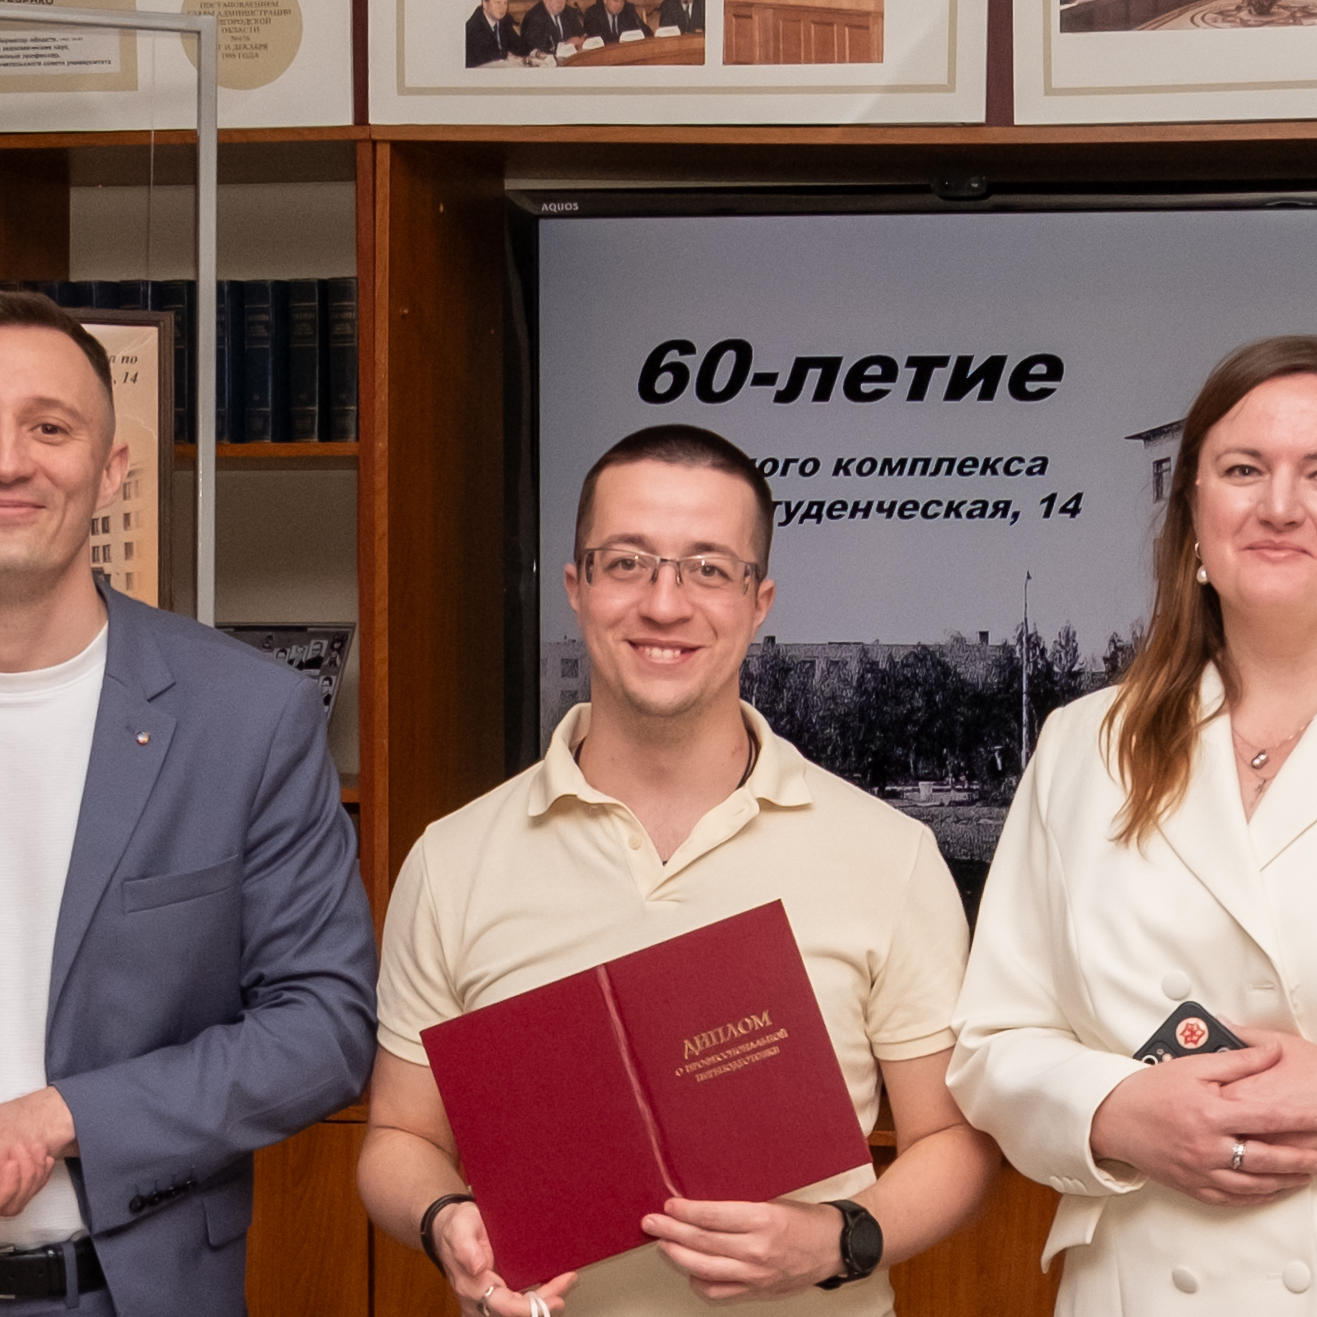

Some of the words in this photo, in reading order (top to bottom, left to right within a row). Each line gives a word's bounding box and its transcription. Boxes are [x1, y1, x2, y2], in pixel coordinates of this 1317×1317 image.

[541, 202, 579, 213] AQUOS
[121, 355, 138, 365] по
[637, 338, 1065, 404] 60-летие
[123, 371, 139, 384] 14
[831, 455, 1050, 478] комплекса
[772, 499, 1021, 527] туденческая,
[1039, 491, 1085, 519] 14
[683, 1010, 773, 1060] ДИПЛОМ
